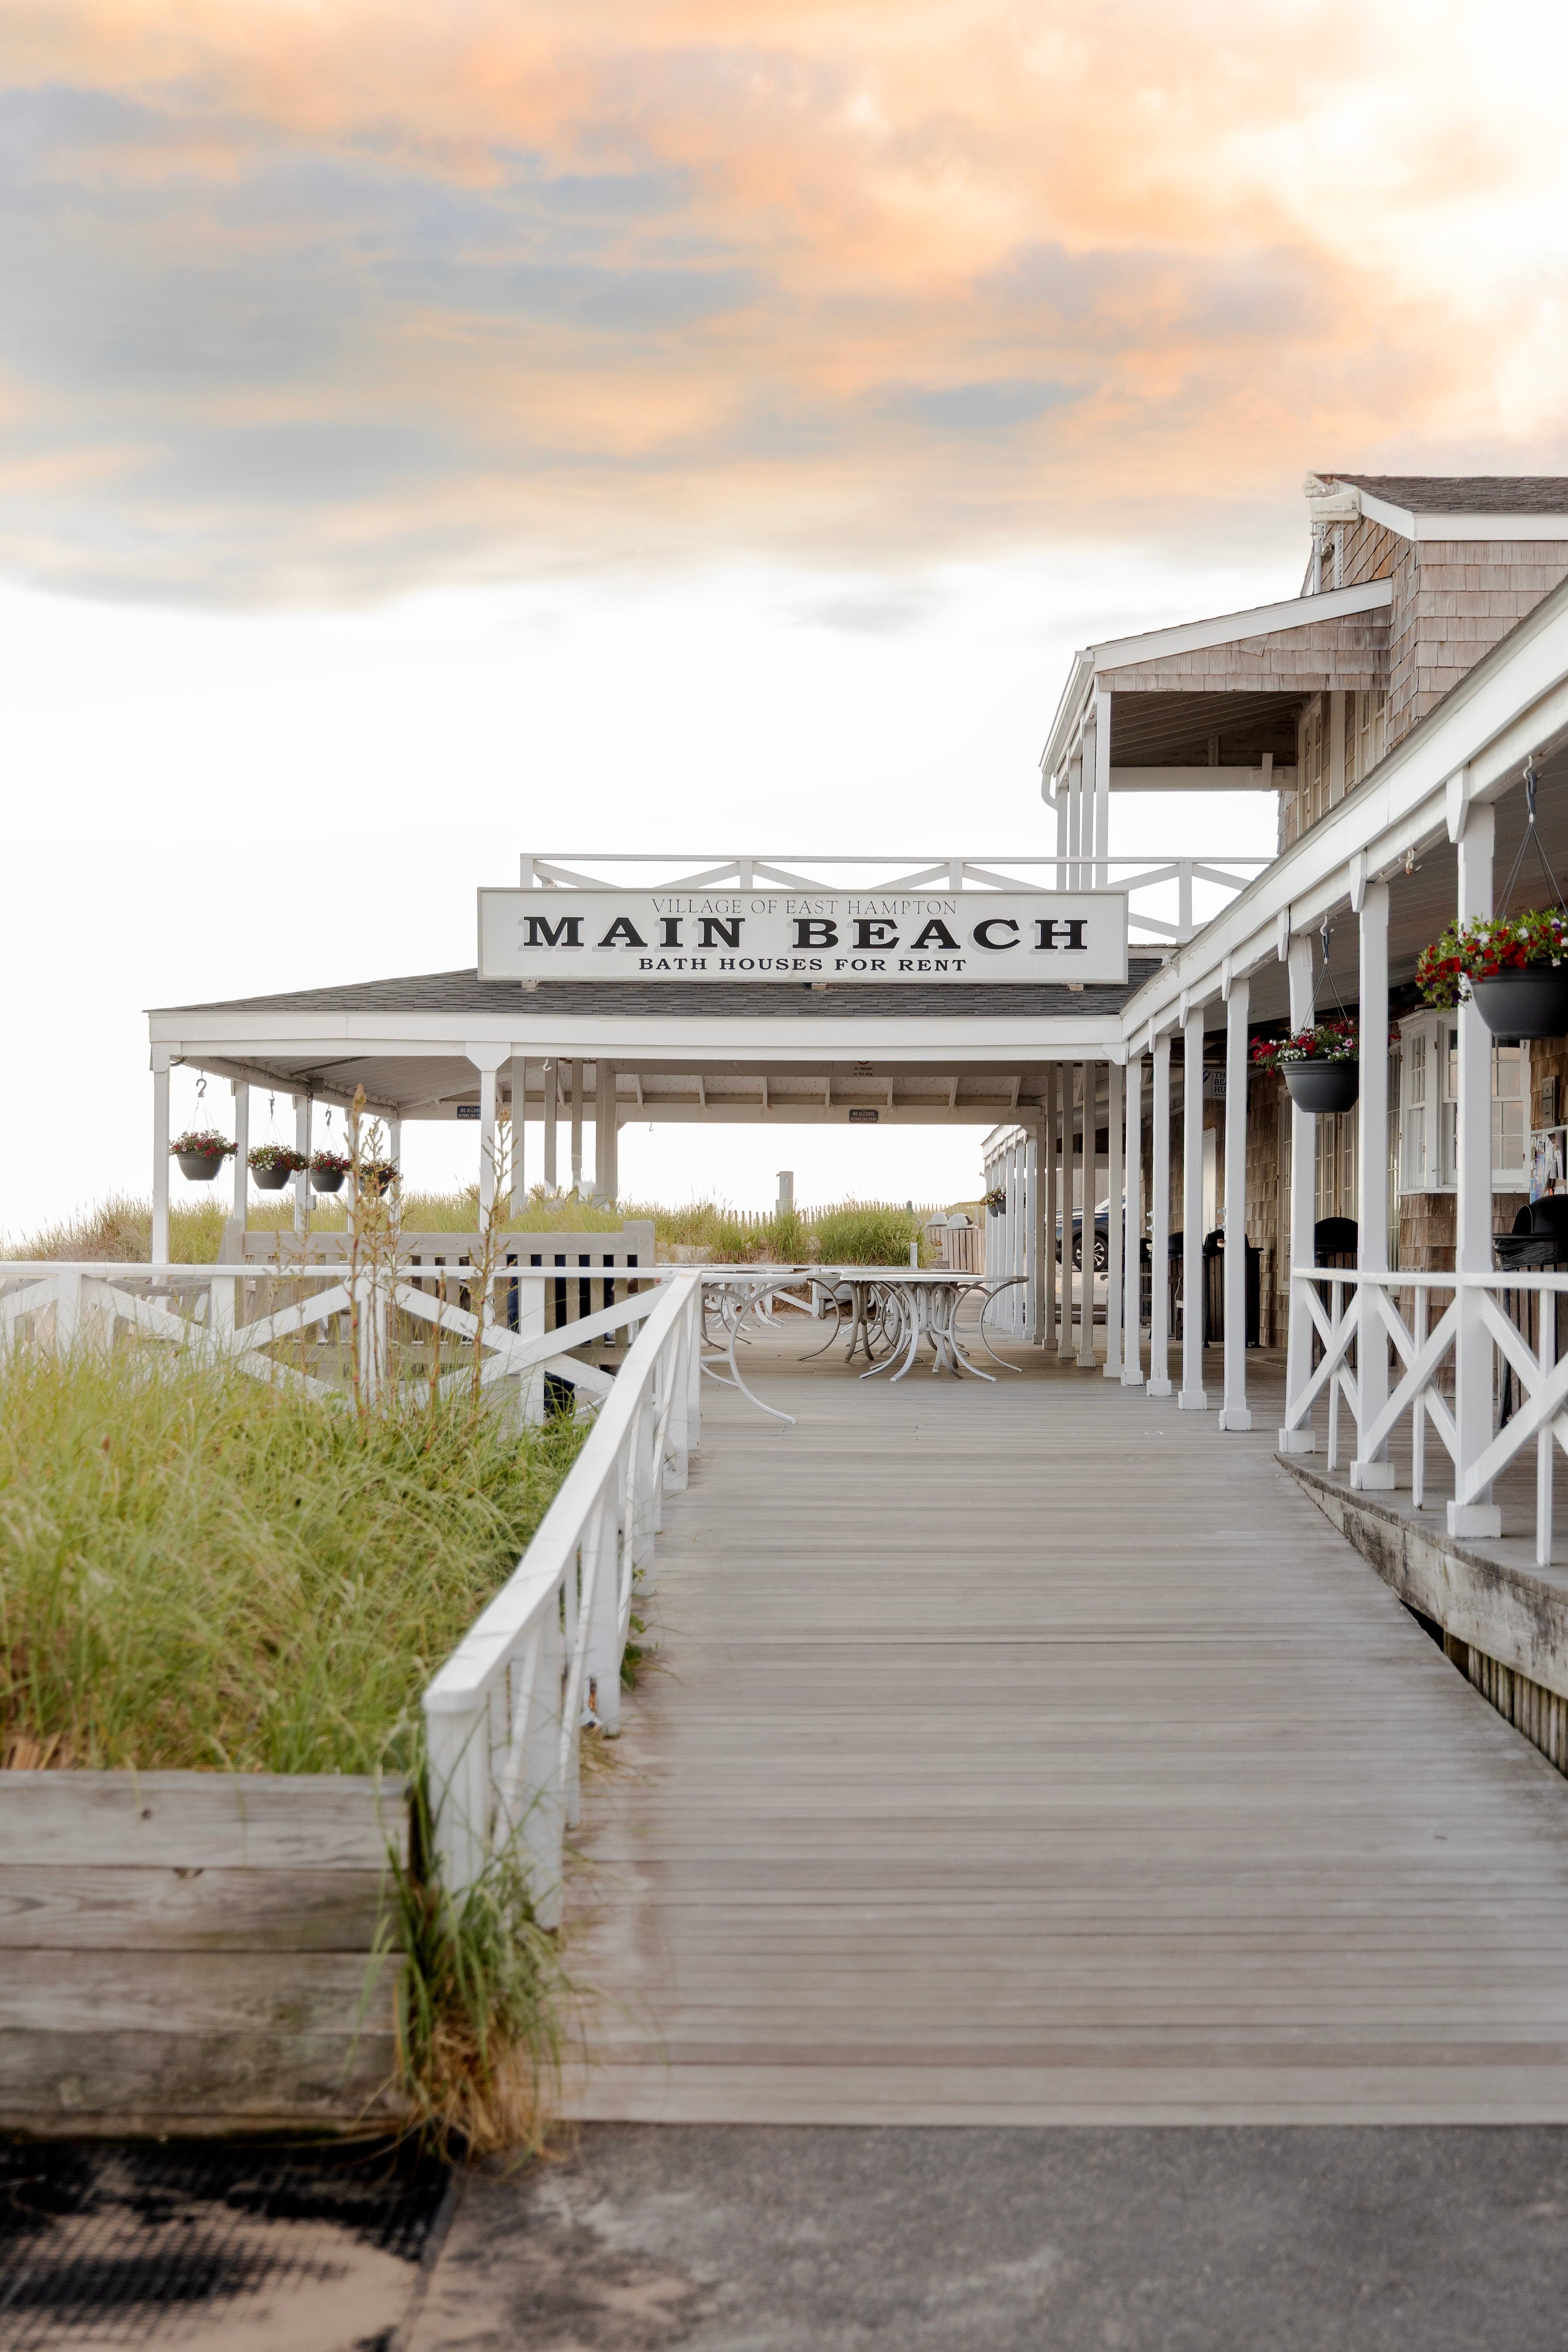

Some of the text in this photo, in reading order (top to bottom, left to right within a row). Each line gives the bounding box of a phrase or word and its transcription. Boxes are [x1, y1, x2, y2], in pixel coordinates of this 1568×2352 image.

[651, 898, 956, 915] VILLAGE OF EAST HAMPTON
[523, 916, 1088, 950] MAIN BEACH
[639, 958, 966, 971] BATH HOUSES FOR RENT
